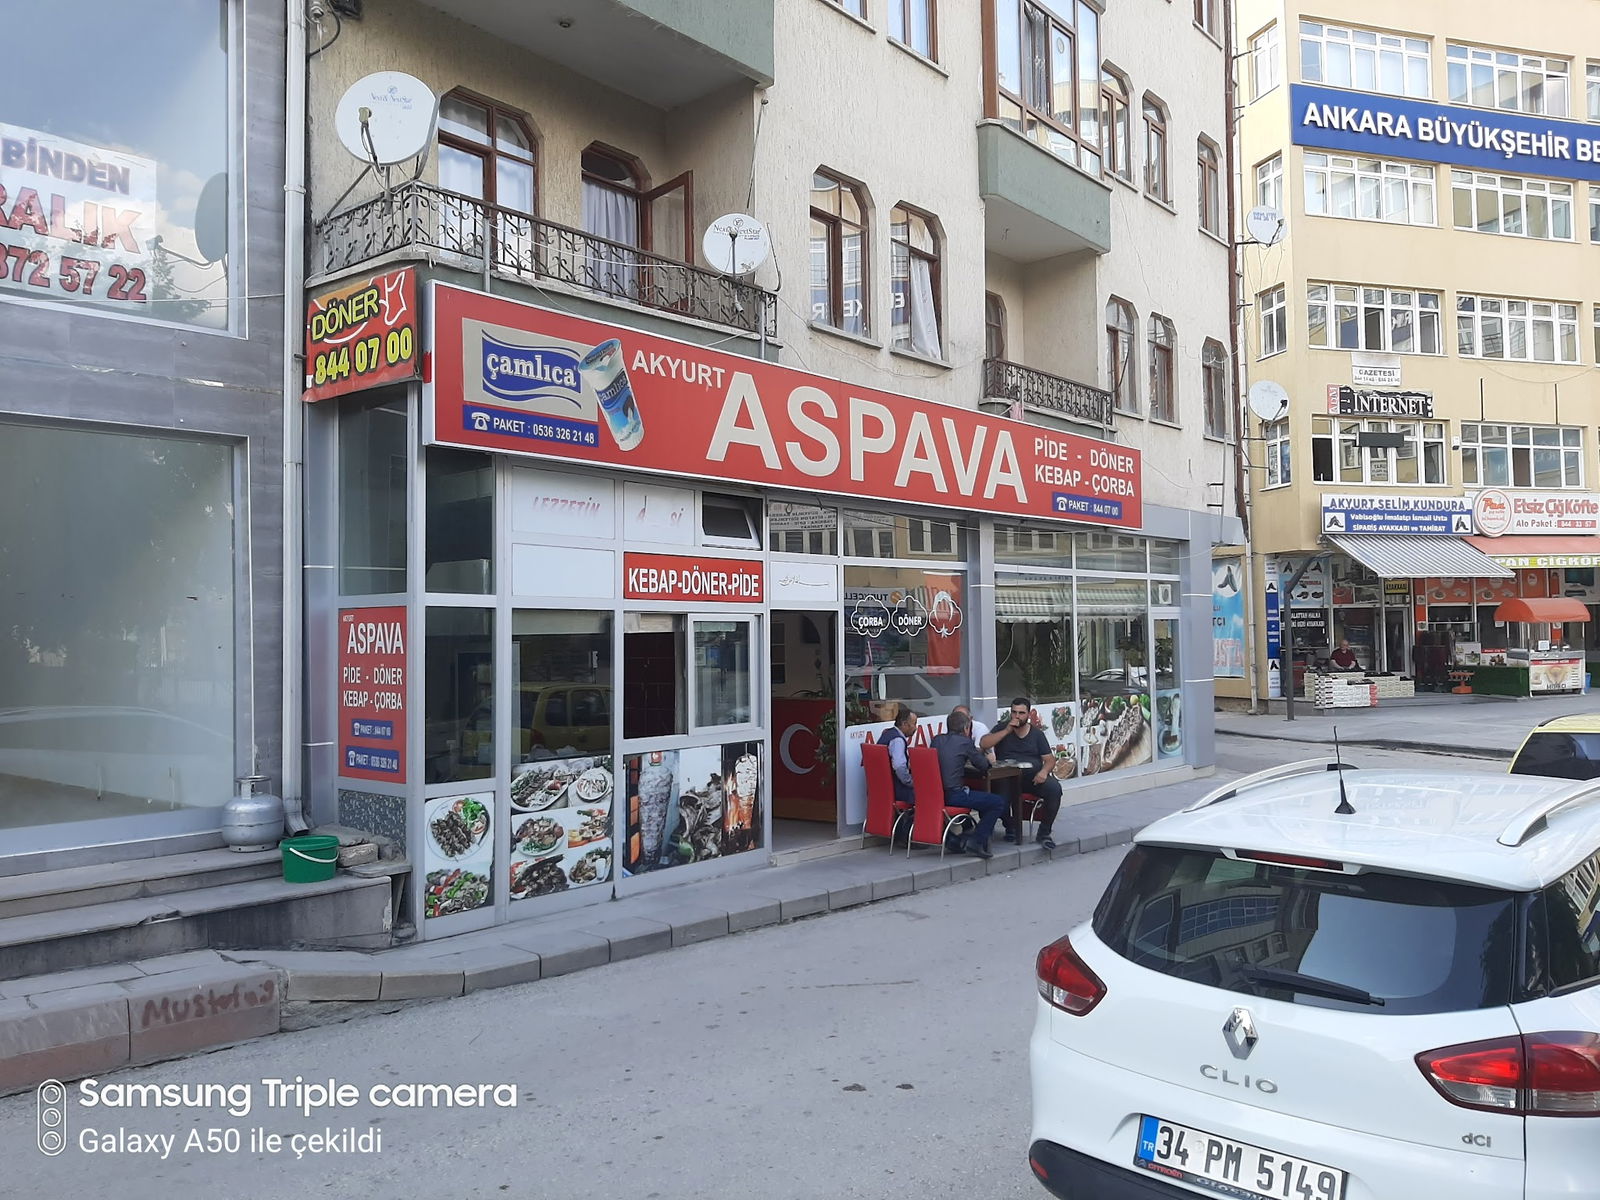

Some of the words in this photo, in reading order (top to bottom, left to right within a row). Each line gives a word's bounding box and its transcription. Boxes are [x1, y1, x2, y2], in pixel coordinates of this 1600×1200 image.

[1304, 102, 1411, 139] ANKARA
[1418, 115, 1571, 158] BÜYÜKŞEHİR
[59, 255, 101, 295] 57
[107, 264, 147, 304] 22
[311, 287, 379, 341] DÖNER
[315, 347, 350, 385] 844
[355, 337, 380, 373] 07
[387, 327, 413, 364] 00
[486, 354, 577, 388] çamlıca
[632, 349, 725, 388] AKYURT
[493, 417, 525, 433] PAKET
[533, 423, 553, 437] 0536
[556, 427, 570, 440] 326
[573, 430, 582, 442] 21
[585, 432, 595, 444] 48
[705, 371, 1028, 504] ASPAVA
[1034, 435, 1068, 461] PİDE
[1090, 448, 1135, 474] DÖNER
[1034, 463, 1081, 487] KEBAP
[1092, 474, 1135, 497] ÇORBA
[1068, 500, 1089, 512] PAKET
[1093, 503, 1103, 513] 844
[1329, 498, 1374, 510] AKYURT
[1379, 497, 1410, 510] SELİM
[1413, 500, 1466, 511] KUNDURA
[1514, 498, 1544, 514] Etsiz
[1516, 519, 1528, 527] Alo
[1531, 519, 1552, 527] Paket
[628, 566, 759, 597] KEBAP-DÖNER-PİDE
[858, 616, 884, 629] ÇORBA
[898, 613, 922, 626] DÖNER
[346, 622, 404, 655] ASPAVA
[343, 664, 361, 684] PİDE
[373, 664, 403, 686] DÖNER
[343, 691, 369, 708] KEBAP
[374, 691, 403, 712] ÇORBA
[1200, 1064, 1278, 1093] CLIO
[1142, 1140, 1154, 1151] TR
[1156, 1126, 1189, 1166] 34
[1204, 1138, 1243, 1183] PM
[1256, 1153, 1336, 1200] 5149
